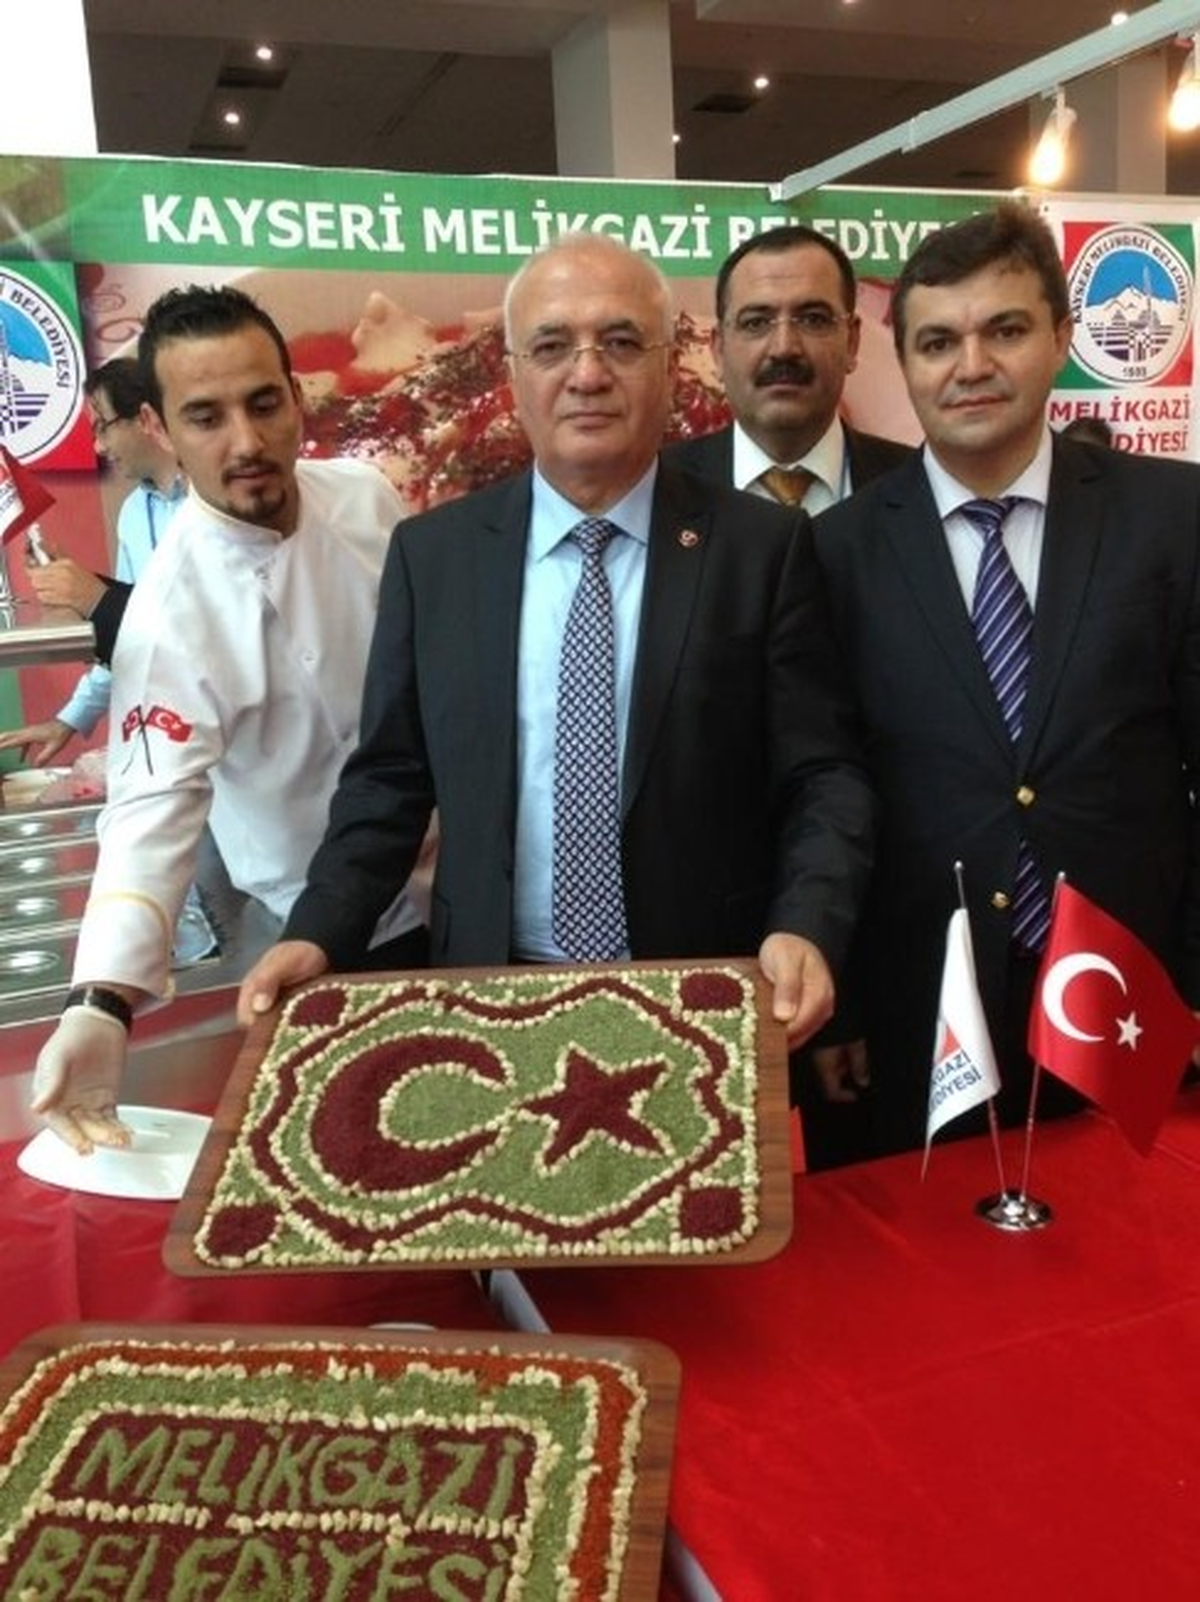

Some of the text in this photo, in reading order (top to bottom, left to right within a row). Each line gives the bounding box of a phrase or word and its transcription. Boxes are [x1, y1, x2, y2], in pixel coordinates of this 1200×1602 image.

[142, 193, 404, 253] KAYSERİ
[1050, 394, 1191, 423] MELİKGAZİ
[1106, 425, 1189, 455] DİYESİ
